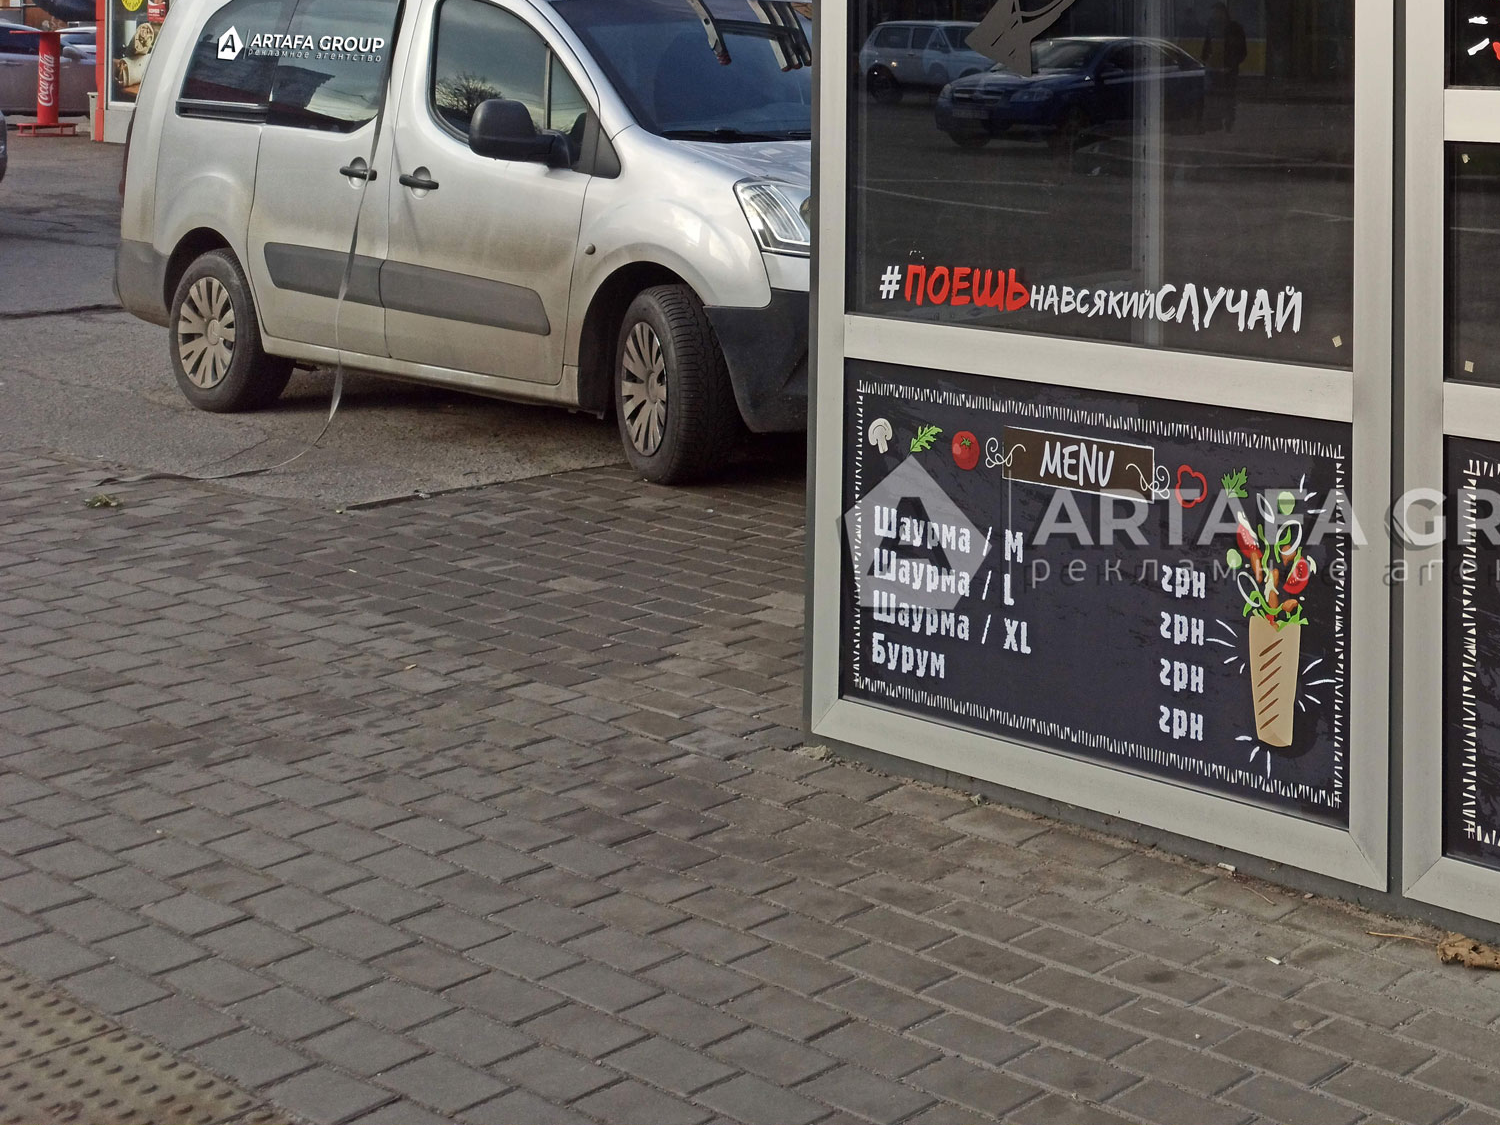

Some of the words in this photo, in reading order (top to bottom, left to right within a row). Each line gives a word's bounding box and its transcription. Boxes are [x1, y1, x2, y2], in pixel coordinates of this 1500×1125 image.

[248, 48, 310, 59] рекламное
[315, 52, 382, 63] агентство
[250, 33, 315, 49] ARTAFA
[319, 35, 385, 53] GROUP
[1039, 440, 1116, 487] MENU
[874, 505, 971, 554] Шаурма
[1004, 528, 1024, 563] M
[873, 547, 970, 597] Шаурма
[1003, 573, 1015, 606] L
[873, 589, 970, 641] Шаурма
[1003, 617, 1032, 655] XL
[871, 631, 945, 679] Бурум
